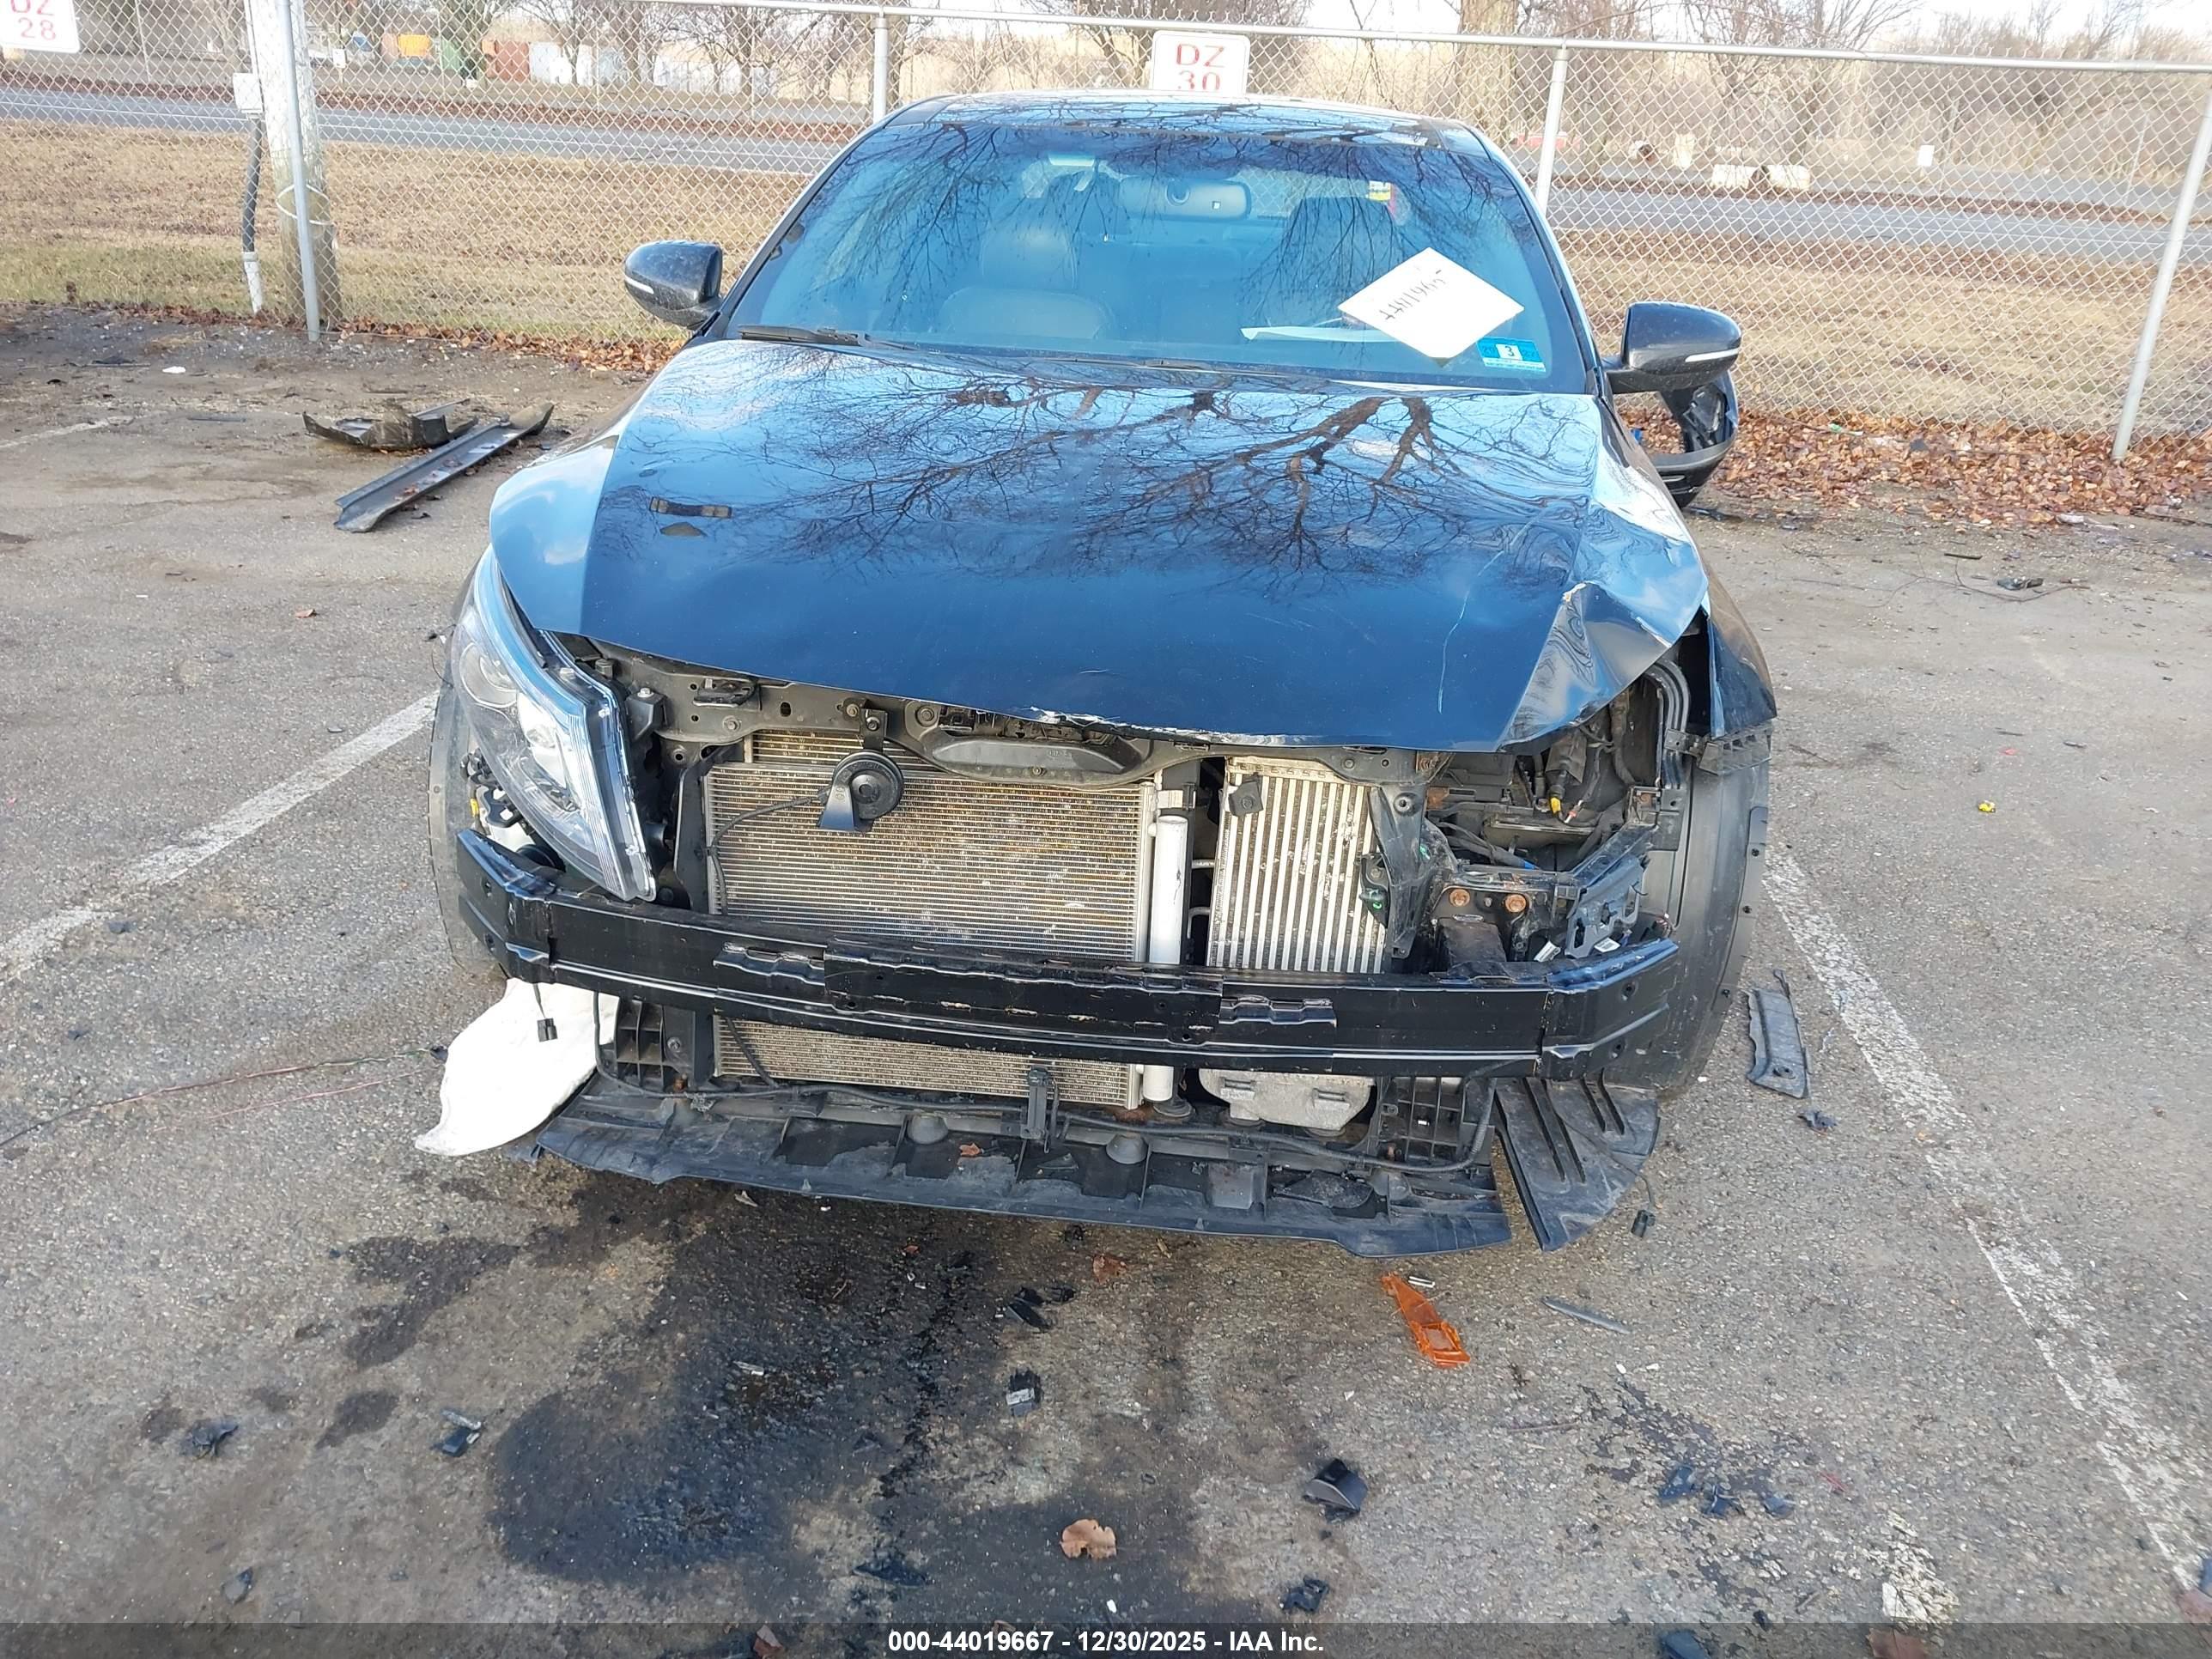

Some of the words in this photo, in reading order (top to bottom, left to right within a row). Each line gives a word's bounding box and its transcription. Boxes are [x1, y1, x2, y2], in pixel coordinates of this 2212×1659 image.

[18, 16, 56, 41] 28
[1176, 43, 1225, 68] DZ
[1177, 70, 1221, 90] 30
[1504, 344, 1516, 357] 3
